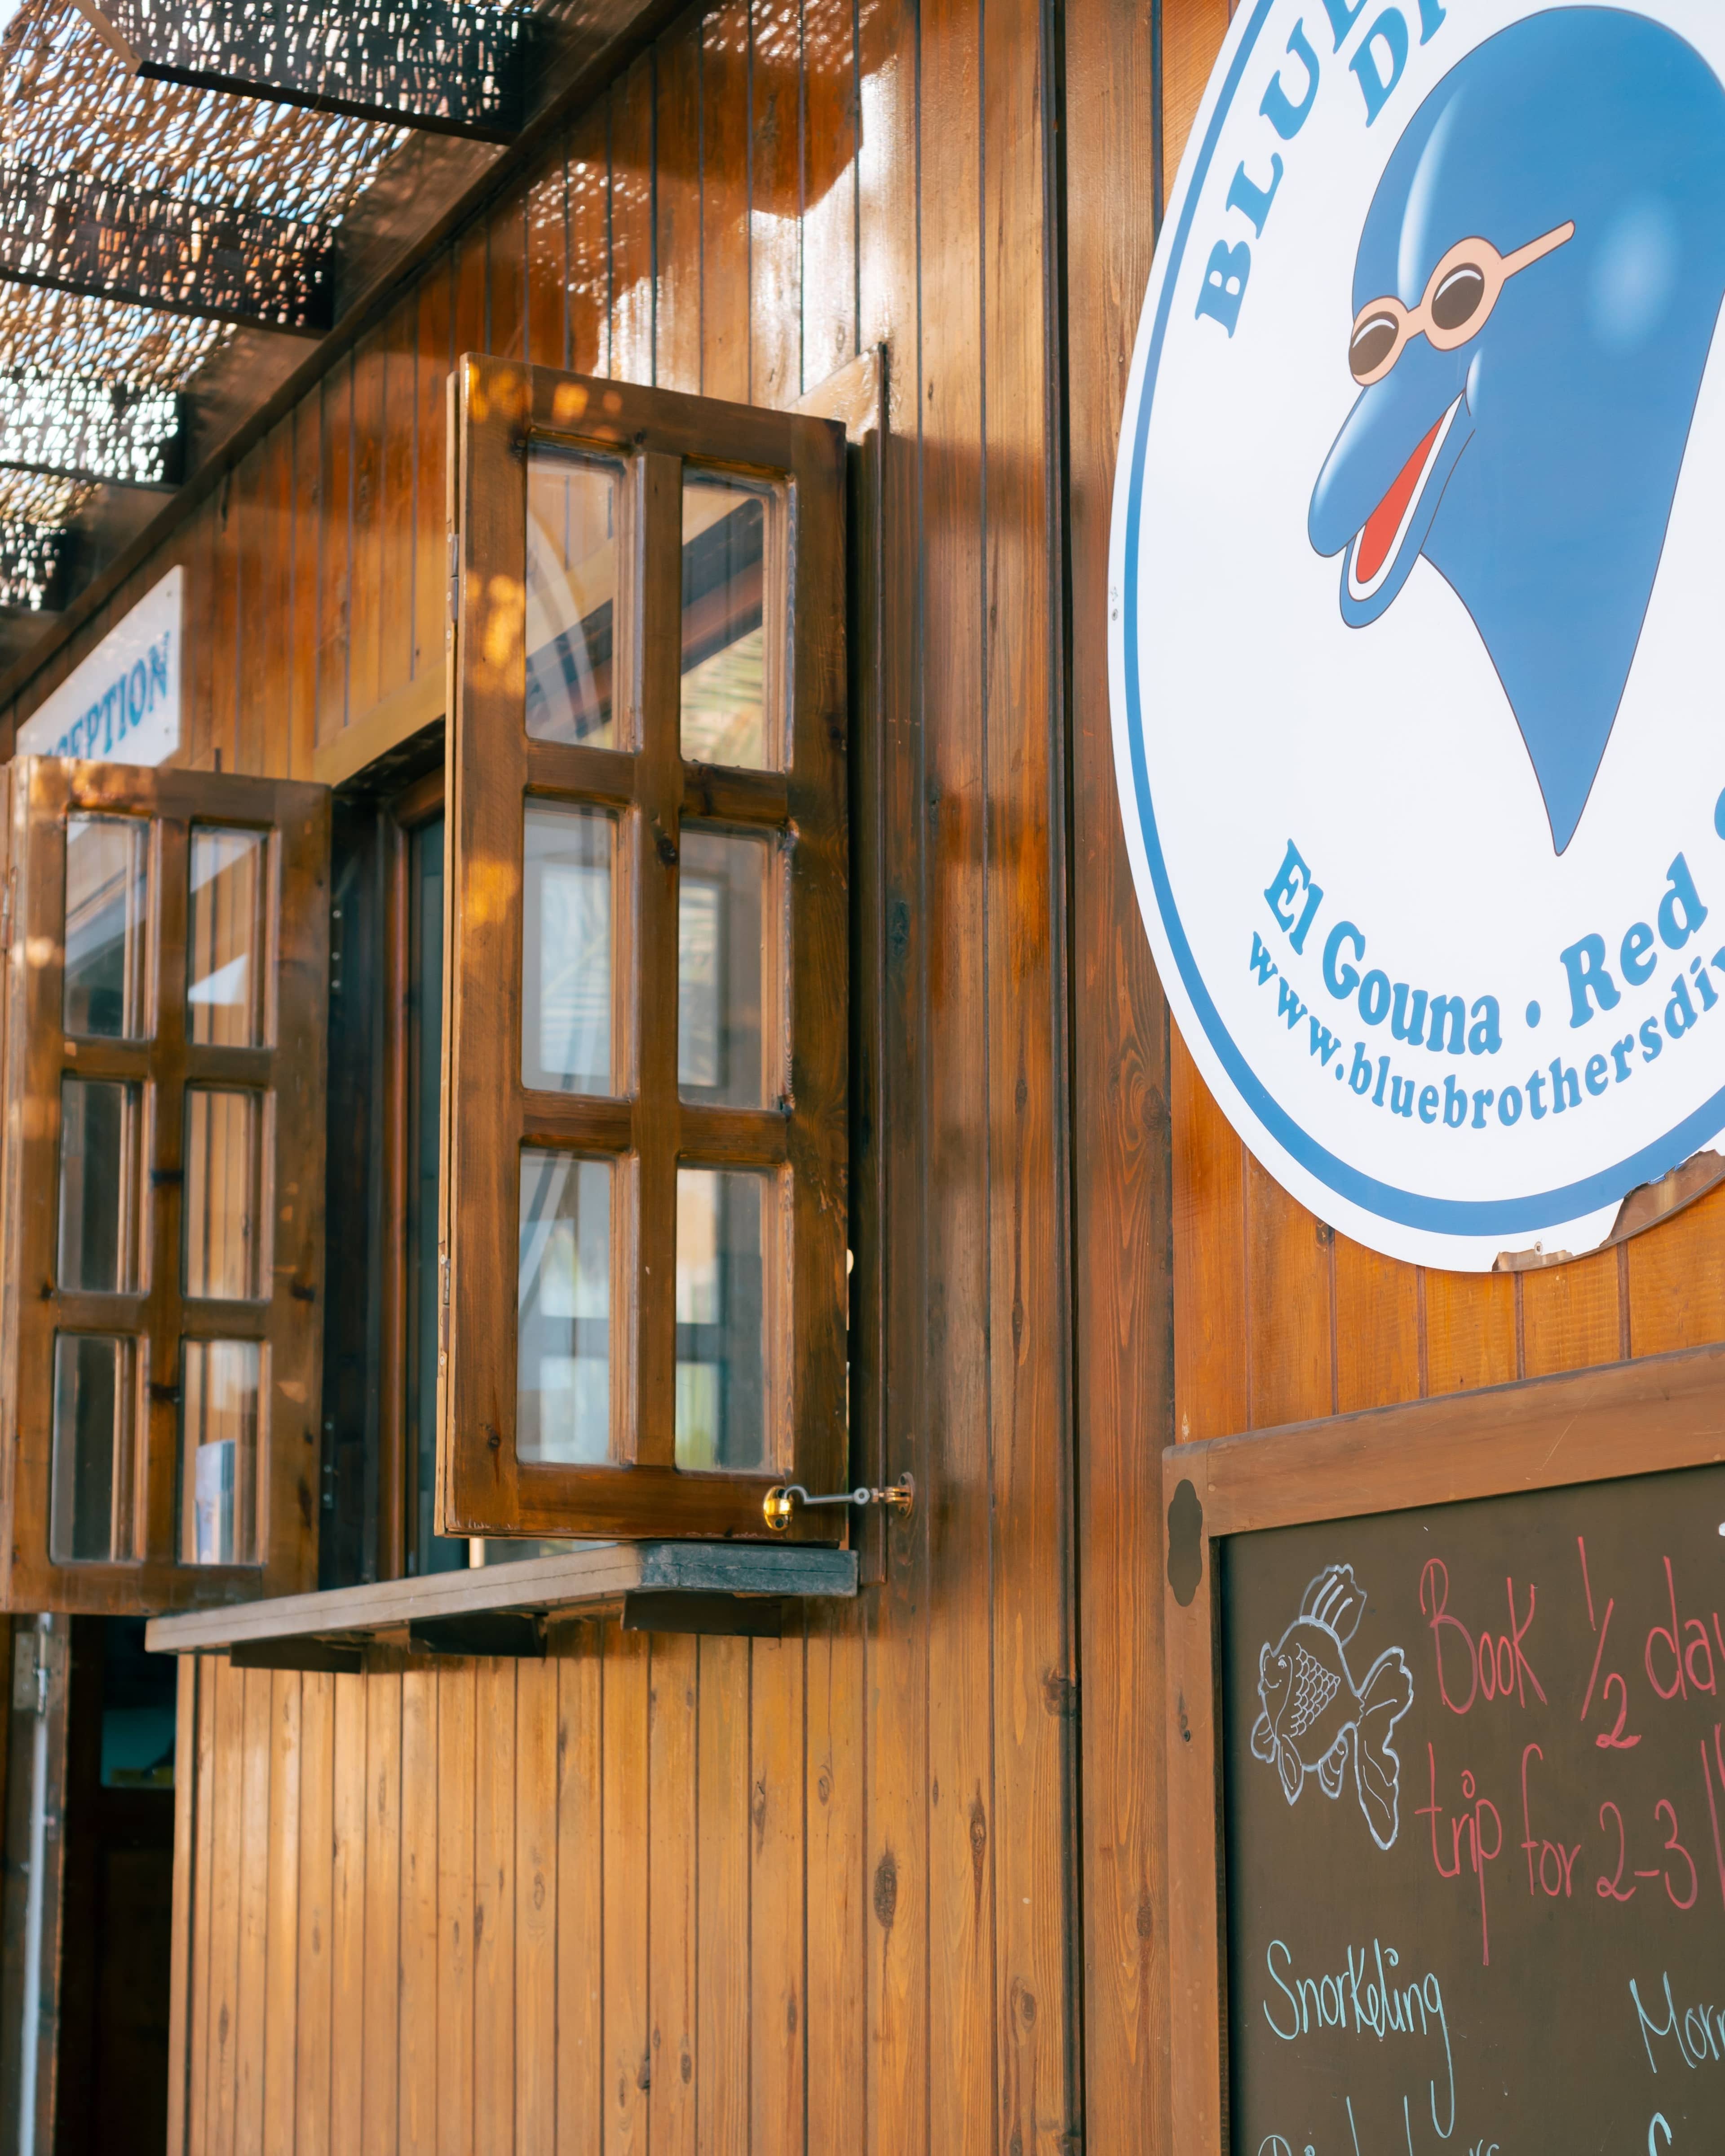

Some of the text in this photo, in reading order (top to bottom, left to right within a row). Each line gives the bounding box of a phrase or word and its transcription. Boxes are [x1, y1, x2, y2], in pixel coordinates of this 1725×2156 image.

[1263, 838, 1708, 1055] El Gouna Red
[1413, 1741, 1503, 1966] trip
[1521, 1743, 1582, 1898] for
[1596, 1798, 1698, 1910] 2-3
